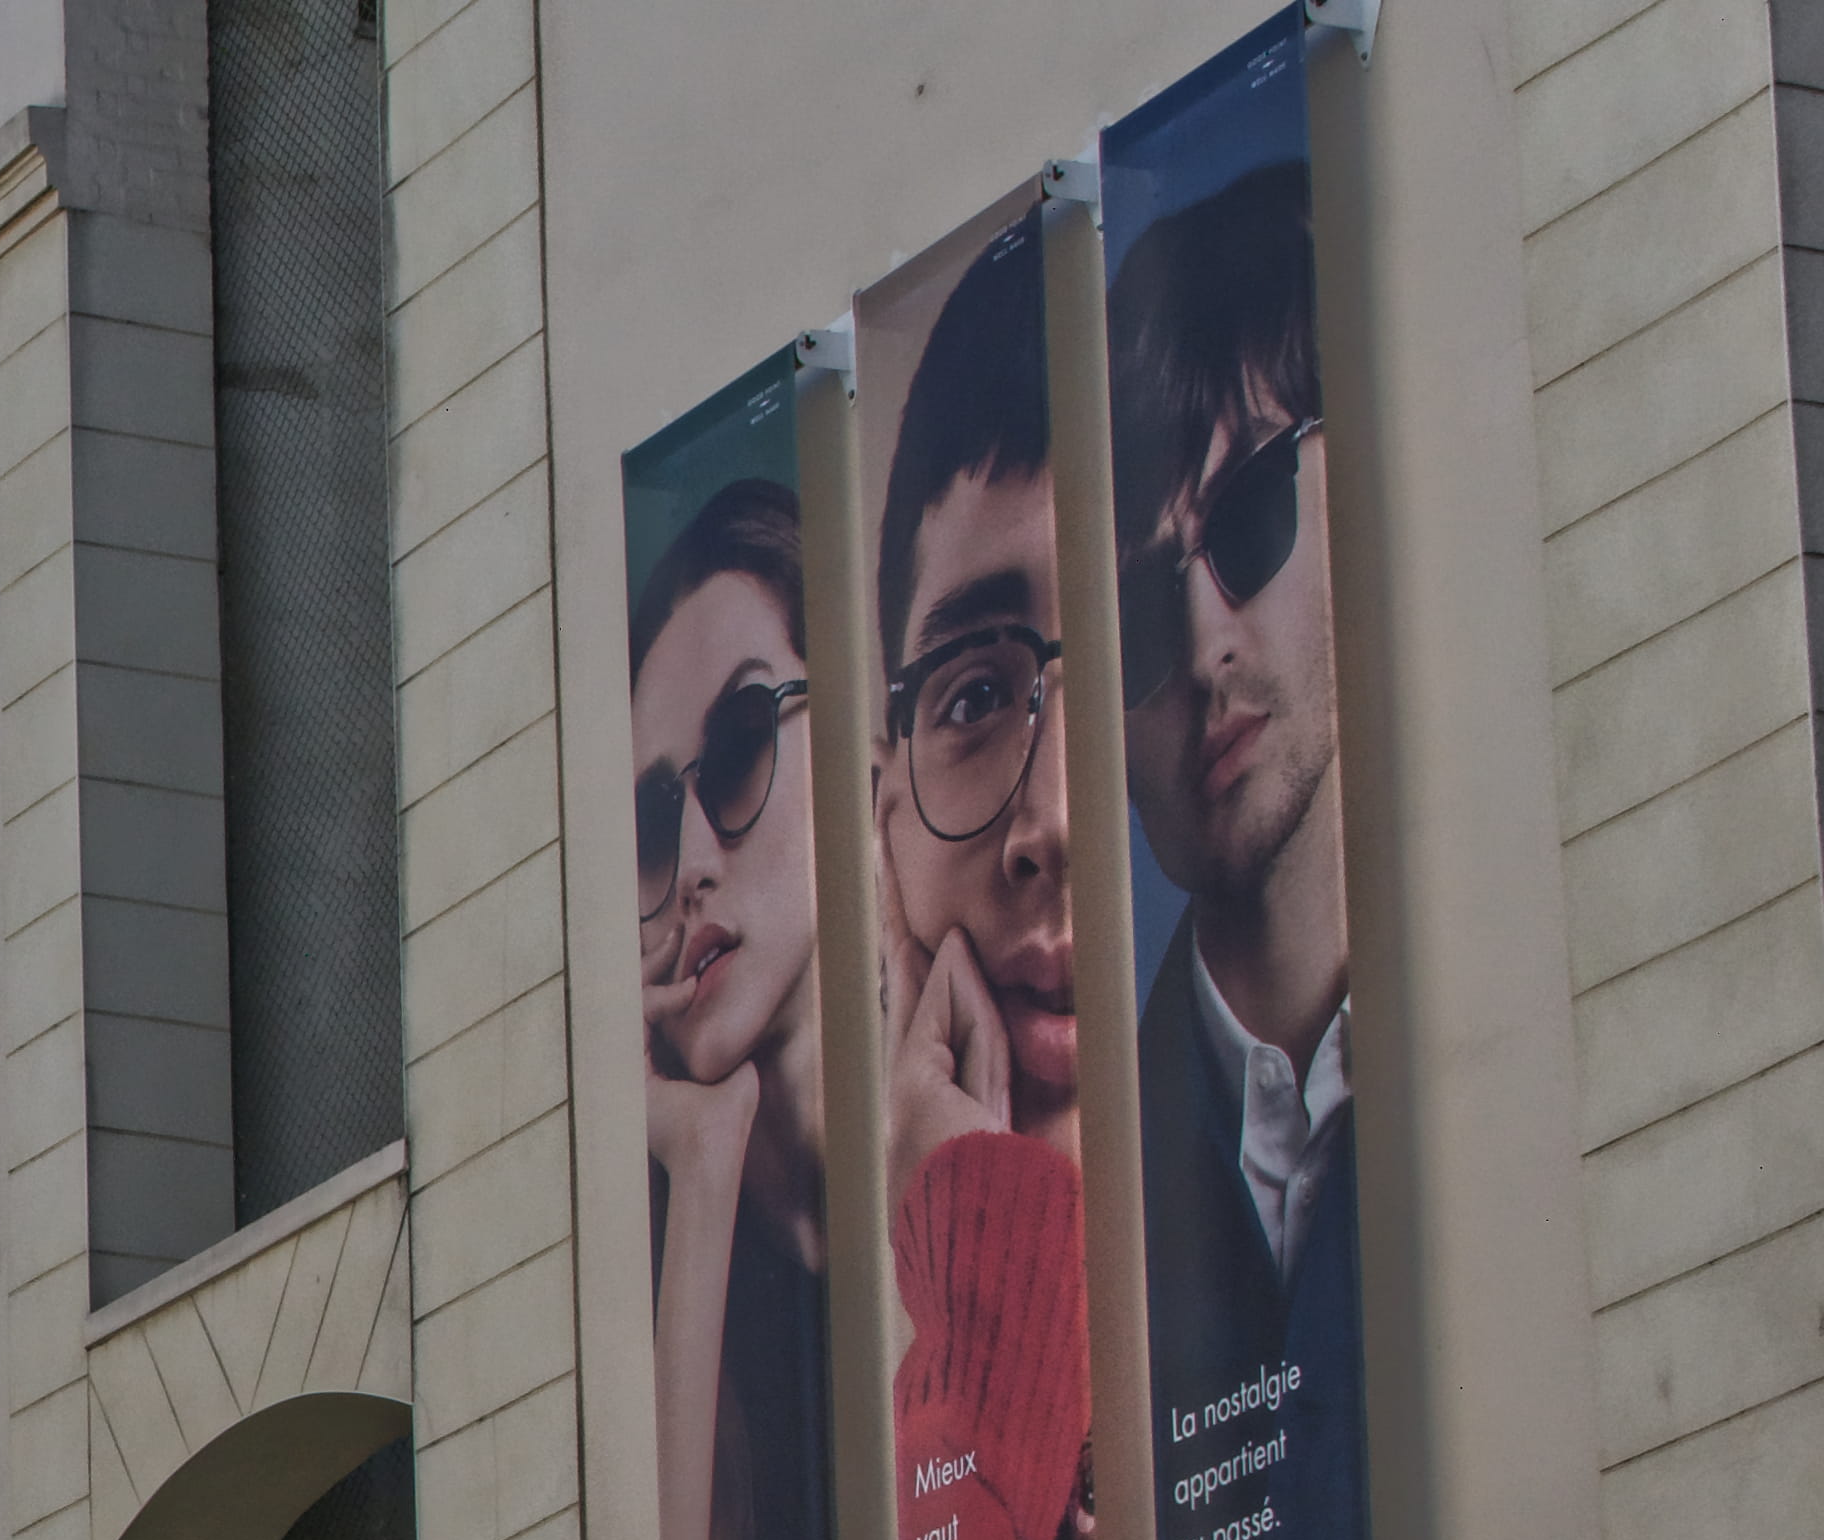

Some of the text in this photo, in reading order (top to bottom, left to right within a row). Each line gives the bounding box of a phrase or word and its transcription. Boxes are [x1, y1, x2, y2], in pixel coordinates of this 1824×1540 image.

[1172, 1360, 1301, 1443] La nostalgie
[914, 1450, 977, 1498] Mieux
[1174, 1428, 1287, 1511] appartient
